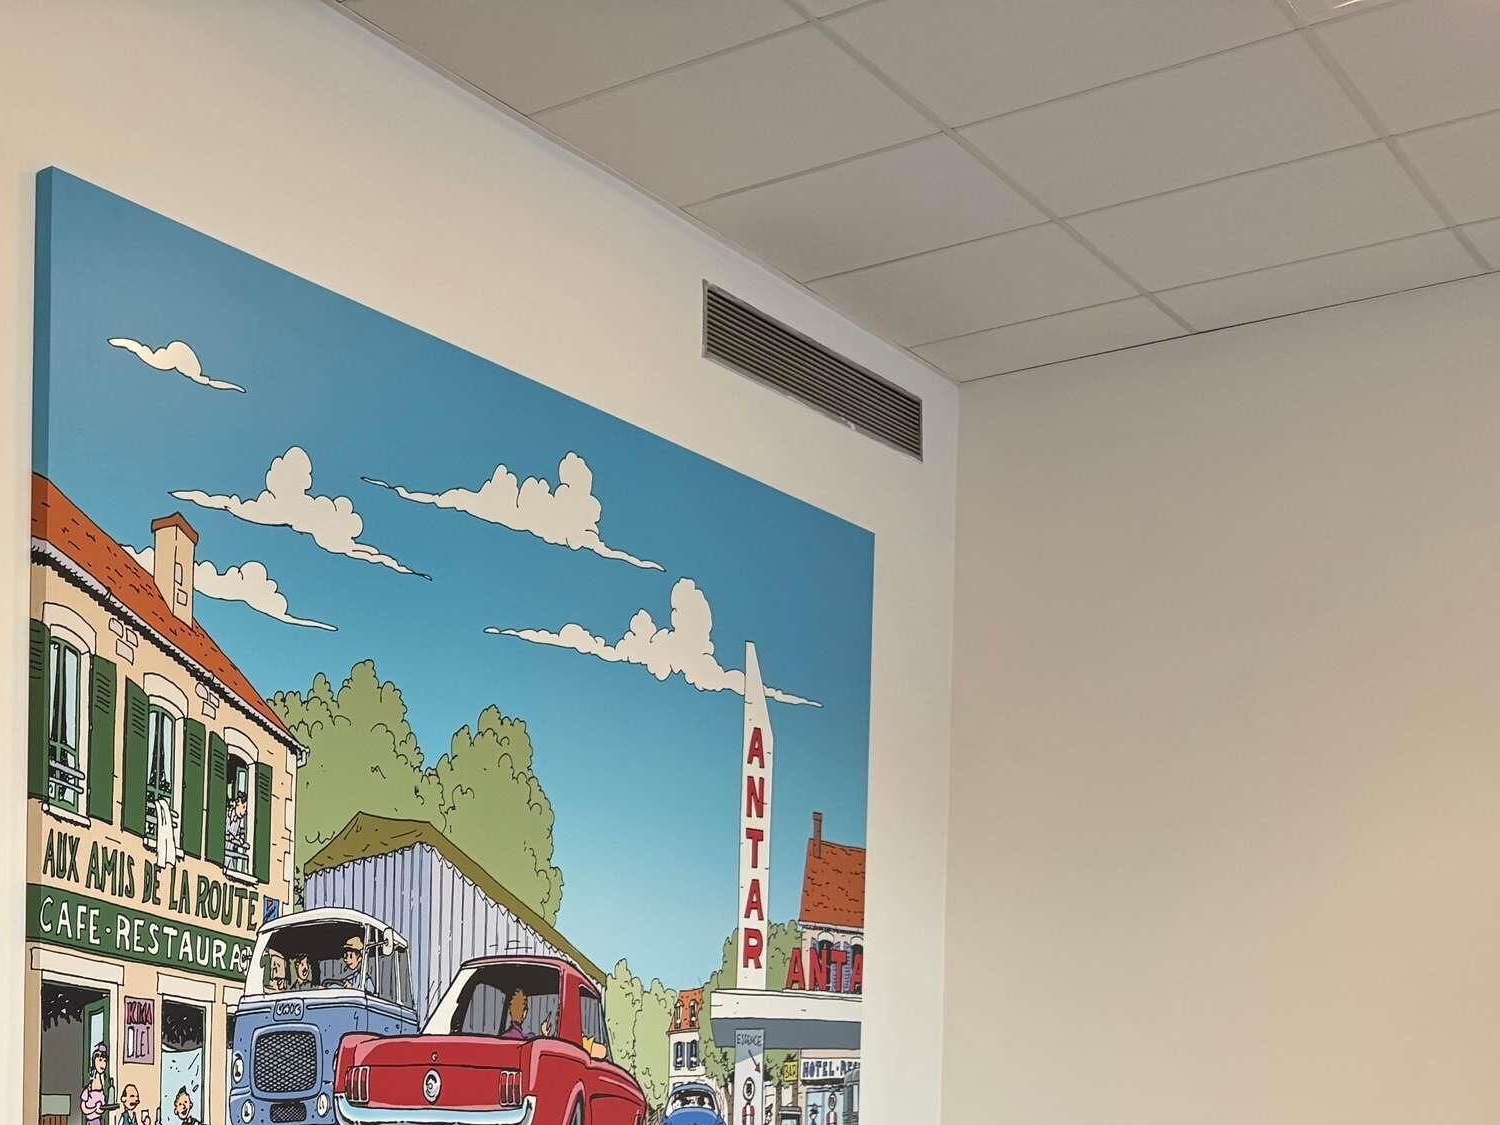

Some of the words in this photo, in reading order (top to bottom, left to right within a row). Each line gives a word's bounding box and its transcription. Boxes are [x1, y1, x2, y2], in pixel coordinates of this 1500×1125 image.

[42, 828, 81, 883] AUX
[85, 841, 135, 899] AMIS
[142, 859, 161, 905] DE
[168, 866, 191, 914] LA
[195, 874, 260, 931] ROUTE
[742, 727, 765, 970] ANTAR
[40, 896, 101, 945] CAFE
[802, 1061, 834, 1078] HOTEL
